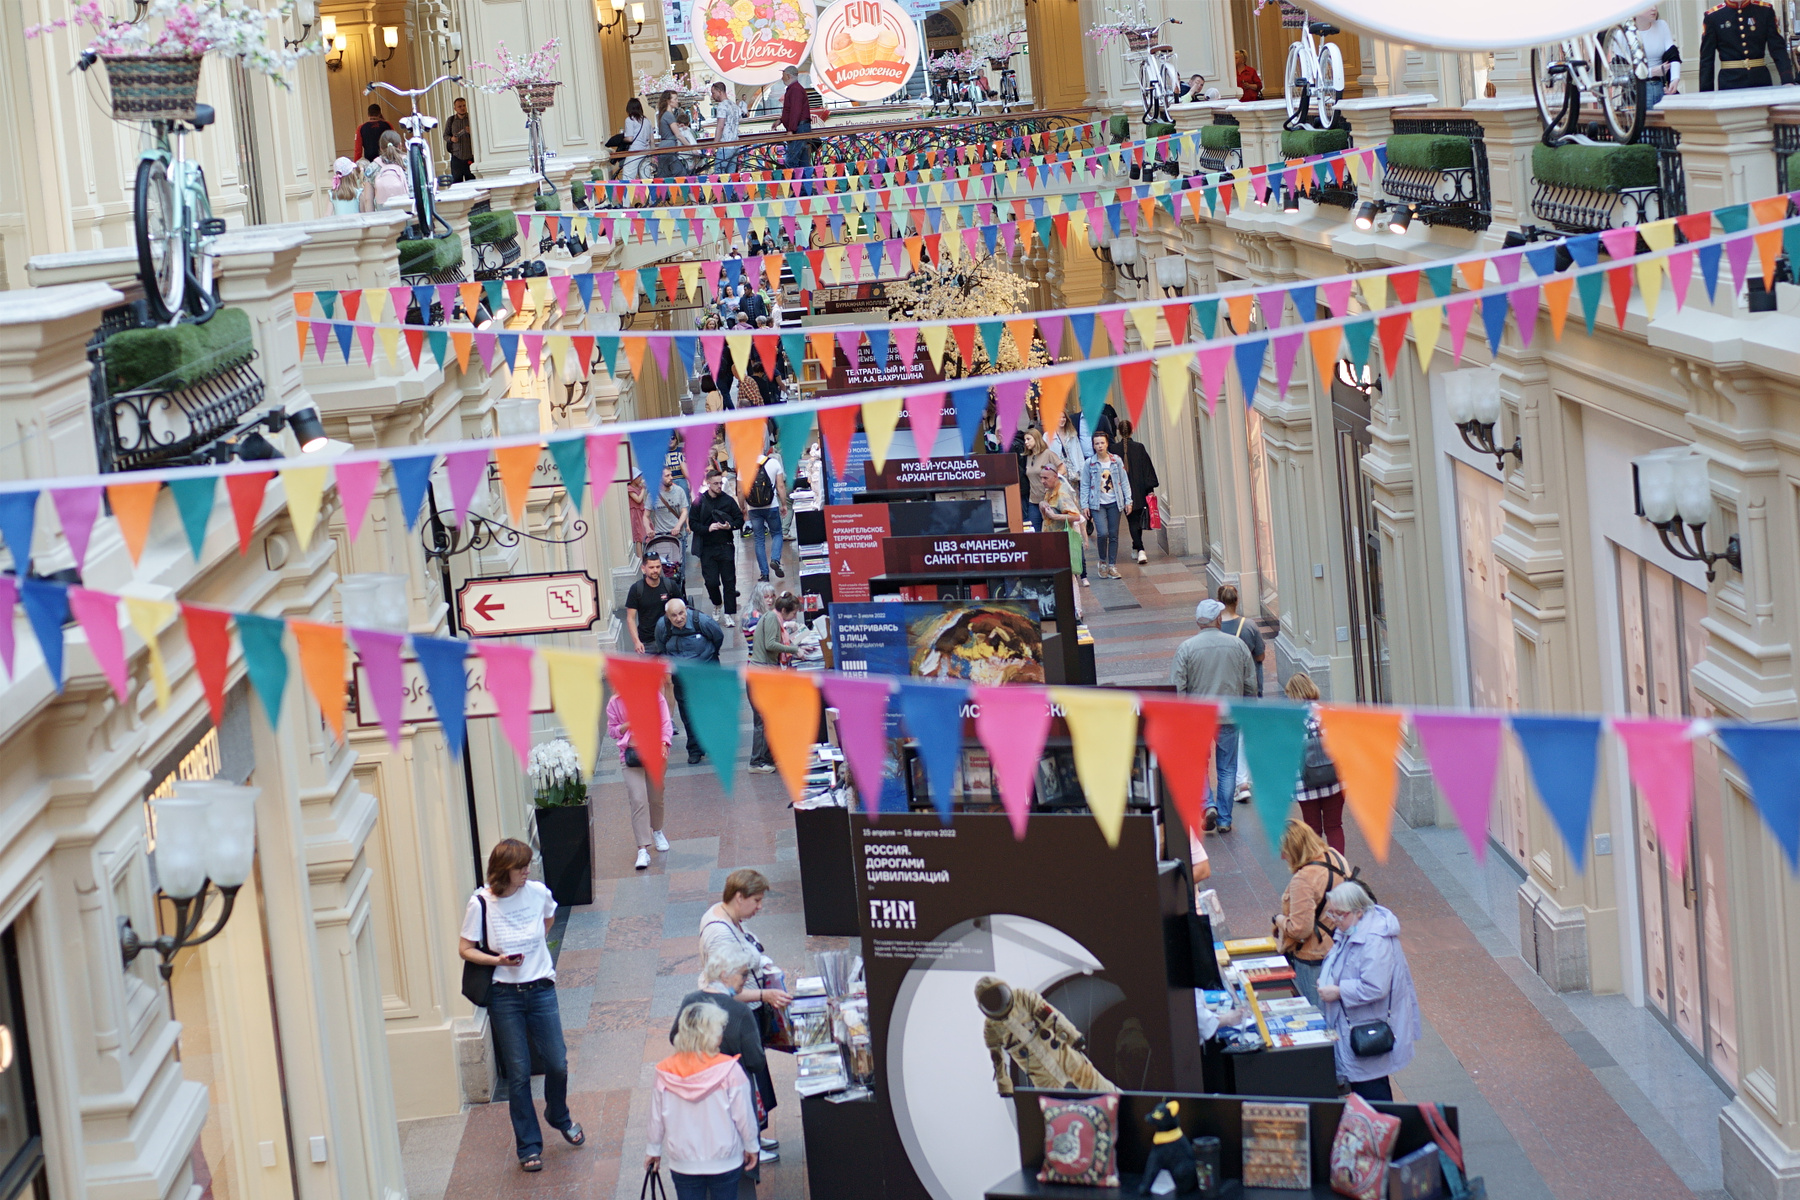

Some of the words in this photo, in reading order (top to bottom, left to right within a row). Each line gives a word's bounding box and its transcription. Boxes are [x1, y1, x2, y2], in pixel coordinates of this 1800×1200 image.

[717, 31, 797, 68] Цветы
[834, 66, 903, 84] Мороженое
[900, 363, 924, 372] МЗЕЙ
[878, 372, 923, 382] БАХРУШИНА
[901, 460, 979, 471] МУЗЕЙ-УСАДЬБА
[896, 470, 986, 482] «АРХАНГЕЛЬСКОЕ»
[833, 526, 885, 534] АРХАНГЕЛЬСКОЕ.
[834, 534, 873, 542] ТЕРРИТОРИЯ
[834, 541, 878, 549] ВПЕЧАТЛЕНИЙ
[934, 541, 957, 553] ЦВЗ
[960, 539, 1016, 551] «МАНЕЖ»
[924, 552, 1028, 565] САНКТ-ПЕТЕРБУРГ
[839, 624, 898, 632] ВСМАТРИВАЯСЬ
[847, 634, 868, 642] ЛИЦА
[863, 828, 871, 836] 15
[904, 829, 912, 837] 15
[913, 830, 938, 838] августа
[939, 829, 956, 837] 2022
[864, 845, 911, 855] РОССИЯ.
[866, 858, 925, 869] ДОРОГАМИ
[867, 870, 949, 884] ЦИВИЛИЗАЦИЙ
[870, 900, 916, 920] ГИМ
[896, 920, 916, 929] ЛЕТ
